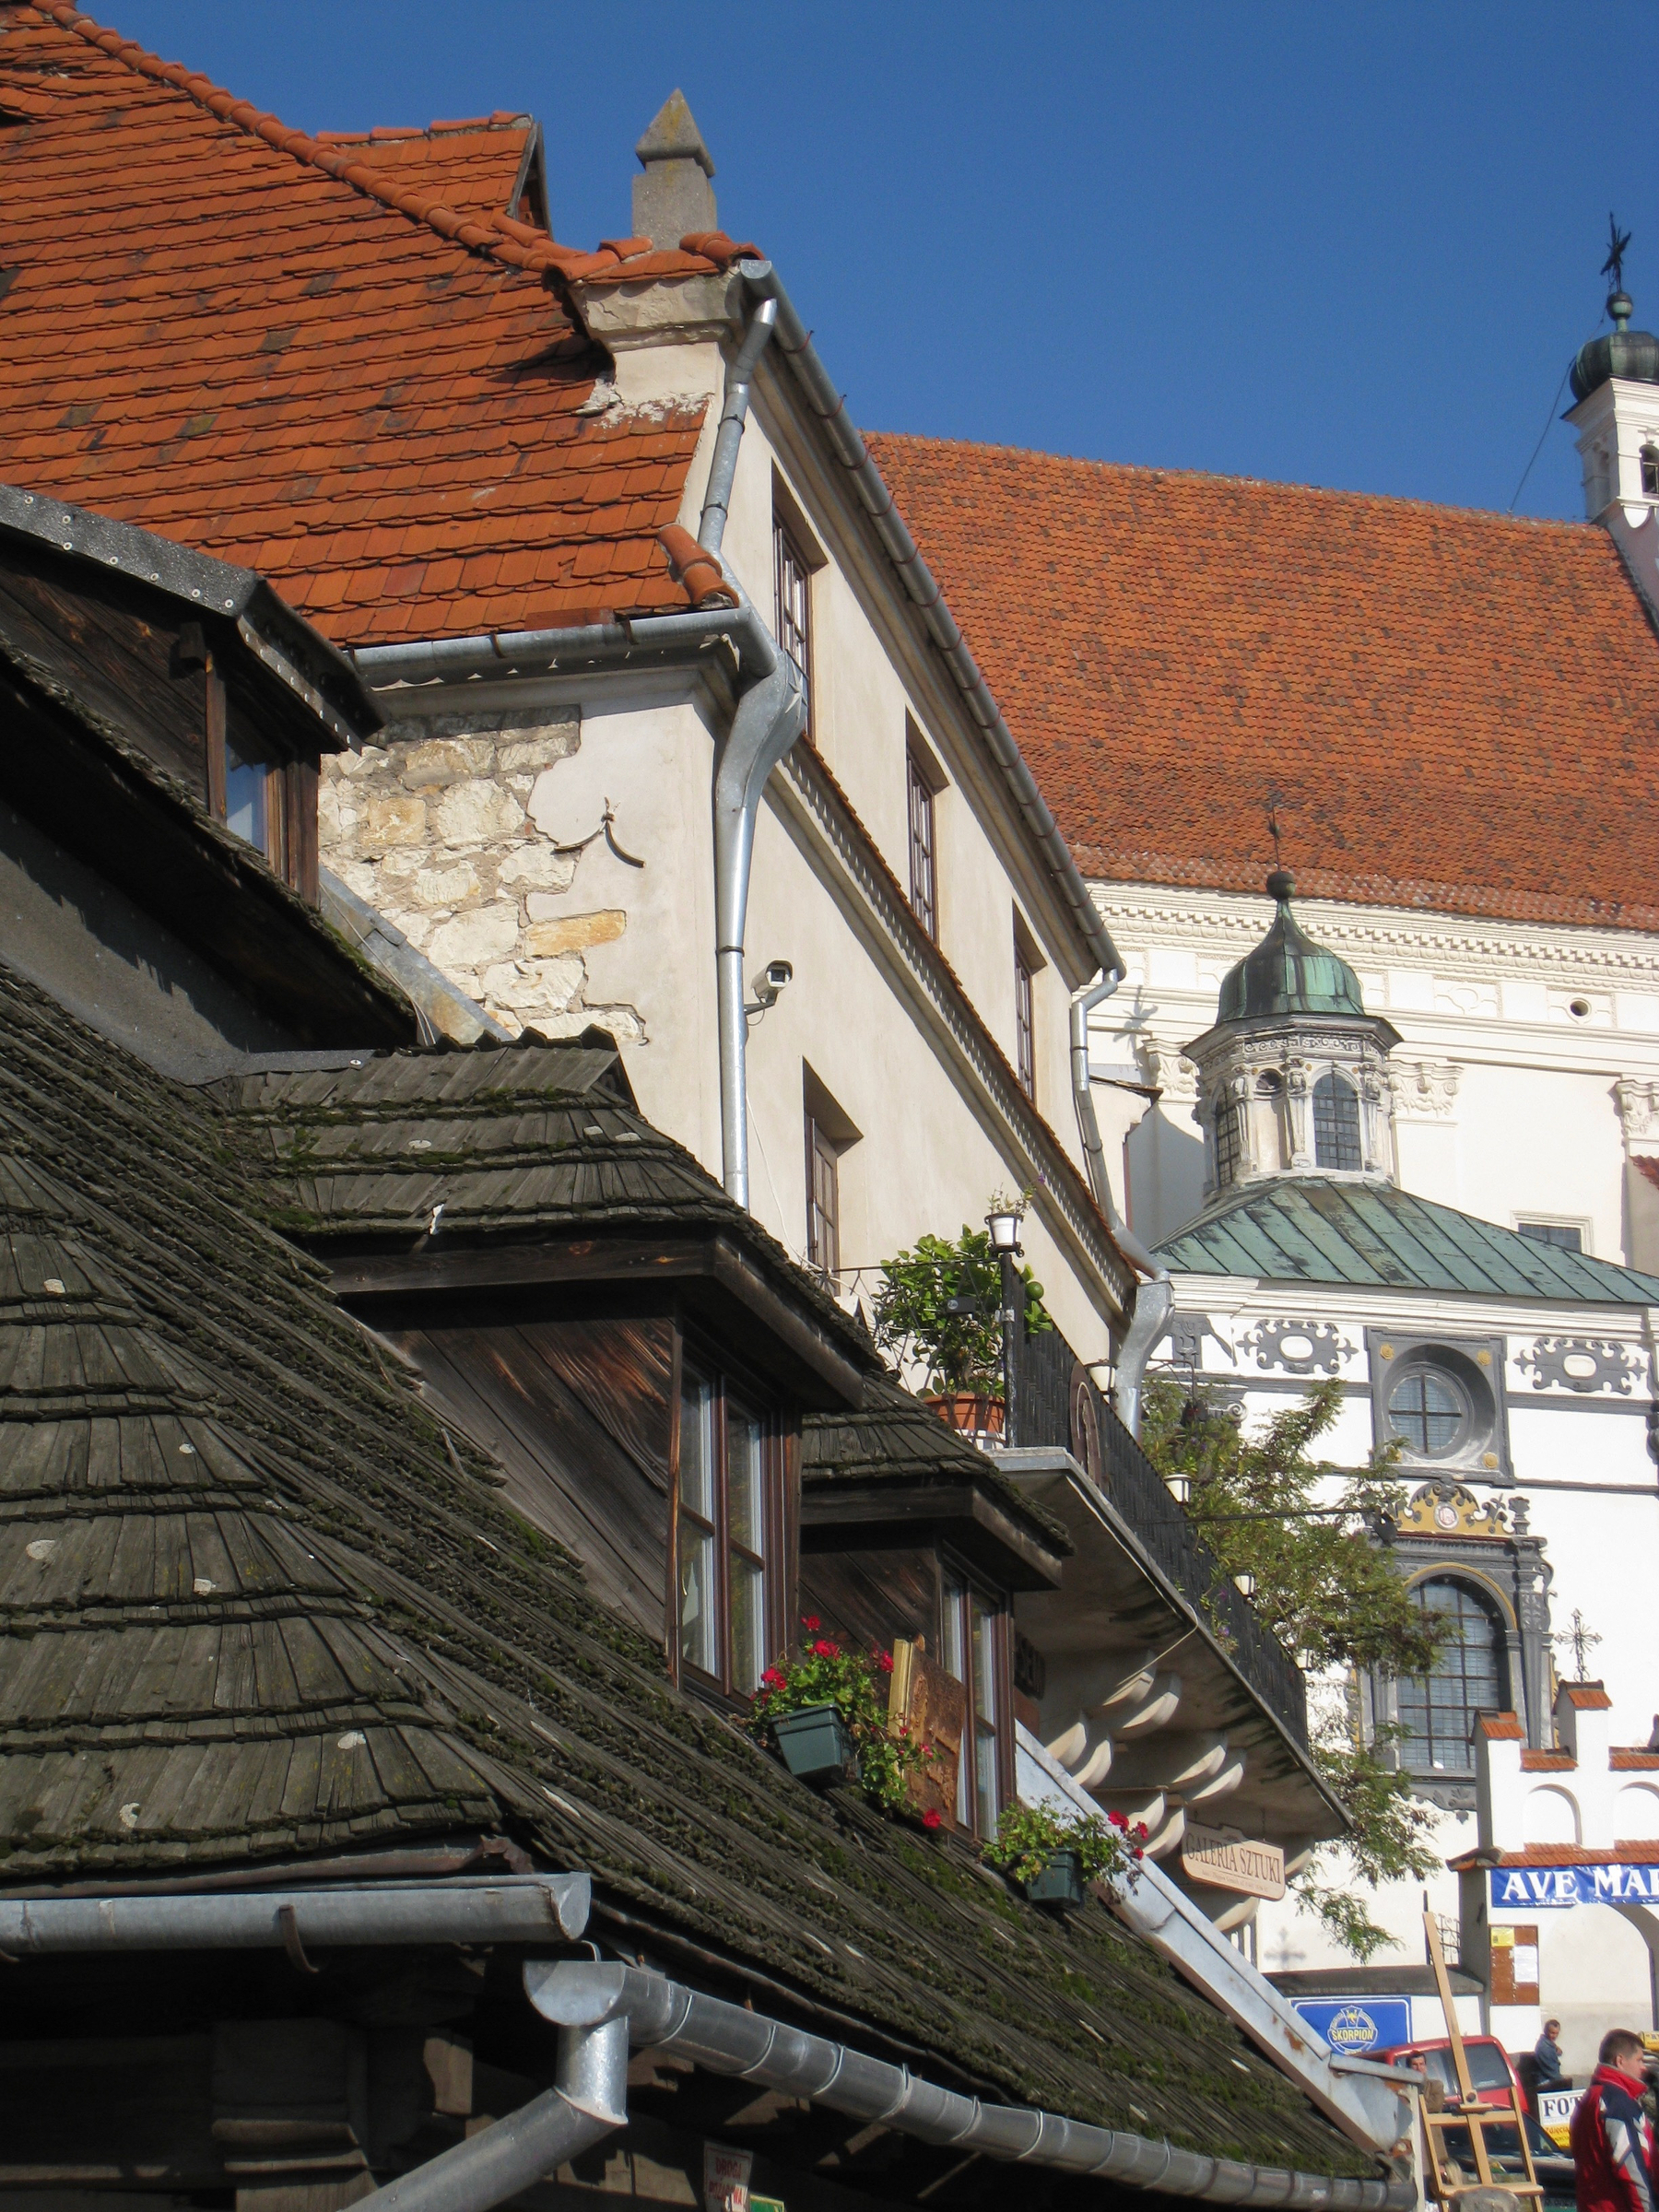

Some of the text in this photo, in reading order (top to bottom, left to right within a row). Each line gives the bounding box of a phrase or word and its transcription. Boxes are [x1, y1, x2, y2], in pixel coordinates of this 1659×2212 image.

[1186, 1832, 1238, 1873] GALERIA
[1240, 1848, 1281, 1884] SZTUKI
[1501, 1870, 1578, 1900] AVE
[1332, 2029, 1373, 2041] SKORPION
